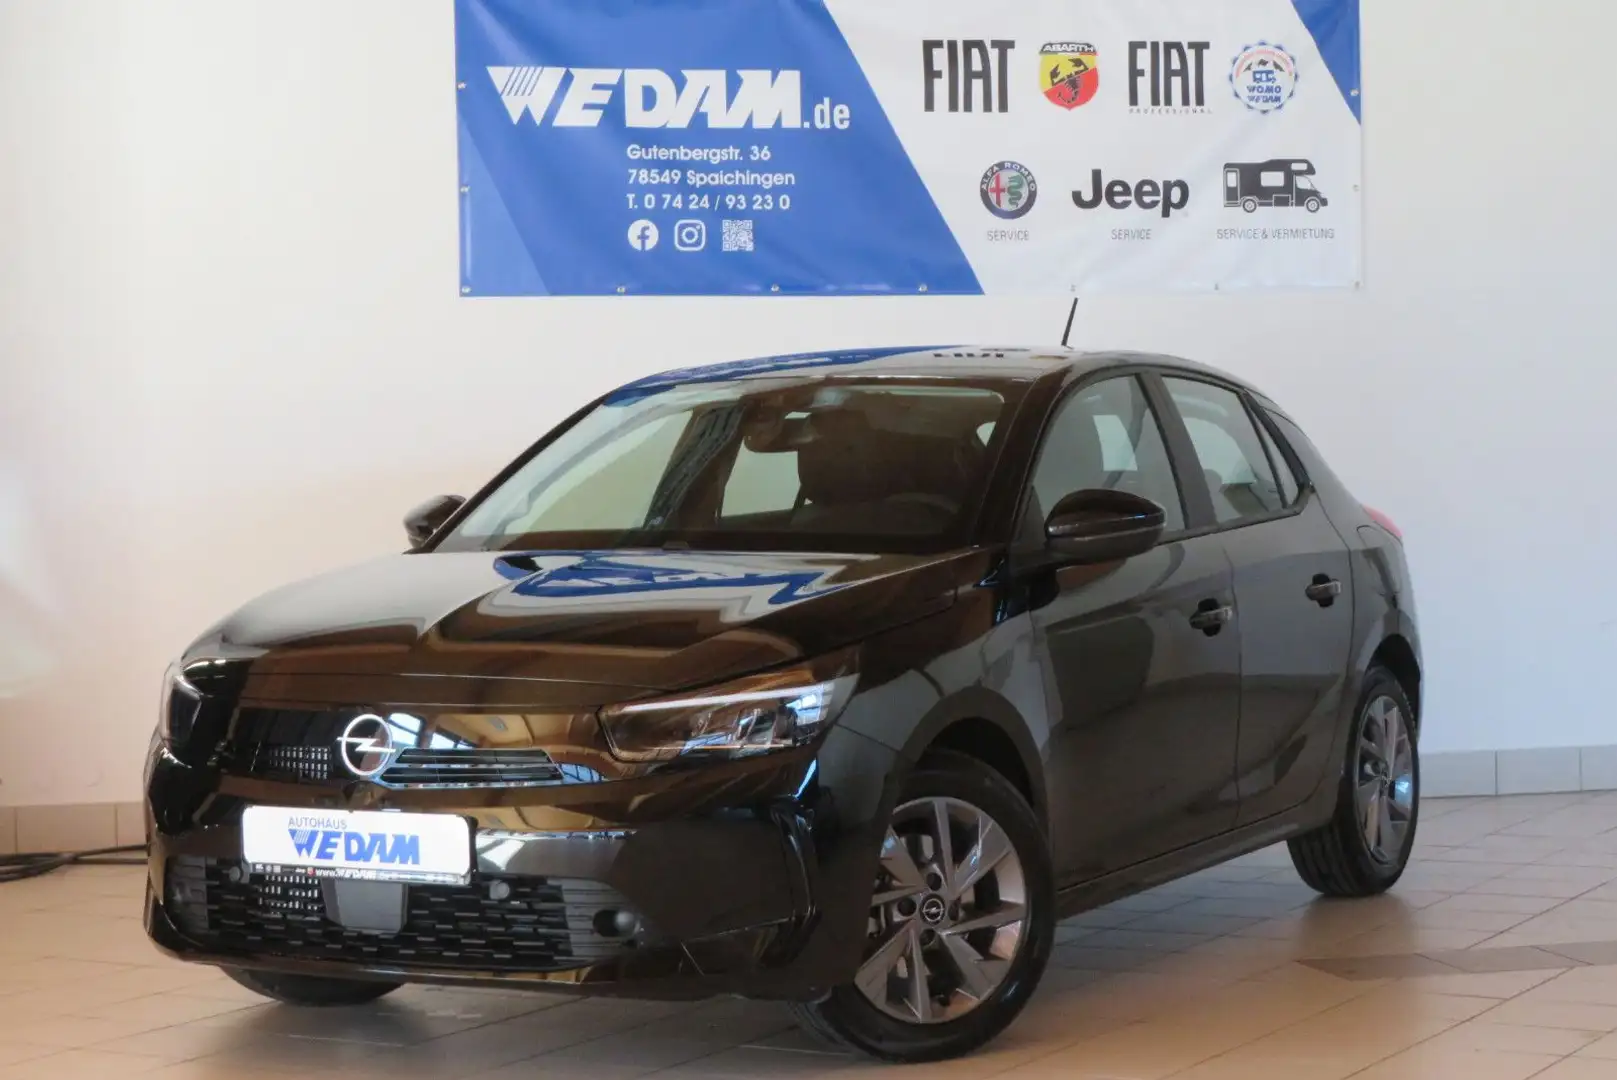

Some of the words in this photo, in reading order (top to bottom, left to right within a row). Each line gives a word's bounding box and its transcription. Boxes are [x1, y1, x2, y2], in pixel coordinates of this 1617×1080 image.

[1042, 43, 1095, 53] ABARTH
[922, 39, 1015, 112] FIAT
[1128, 40, 1210, 107] FIAT
[1246, 85, 1282, 94] WOMO
[626, 144, 744, 165] Gutenbergstr.
[749, 145, 771, 161] 36
[627, 168, 682, 186] 78549
[686, 169, 796, 189] Spaichingen
[981, 164, 1000, 191] ALFA
[1003, 161, 1036, 192] ROMEO
[625, 193, 638, 209] T.
[643, 193, 656, 209] 0
[661, 194, 683, 209] 74
[688, 194, 710, 210] 24
[725, 194, 747, 210] 93
[752, 194, 773, 210] 23
[778, 194, 791, 210] 0
[1071, 168, 1190, 218] Jeep
[986, 229, 1030, 241] SERVICE
[1111, 228, 1152, 240] SERVICE
[1216, 228, 1260, 240] SERVICE
[1261, 228, 1269, 240] &
[1270, 228, 1335, 240] VERMIETUNG
[287, 816, 348, 830] AUTOHAUS
[287, 828, 420, 866] WEDAM
